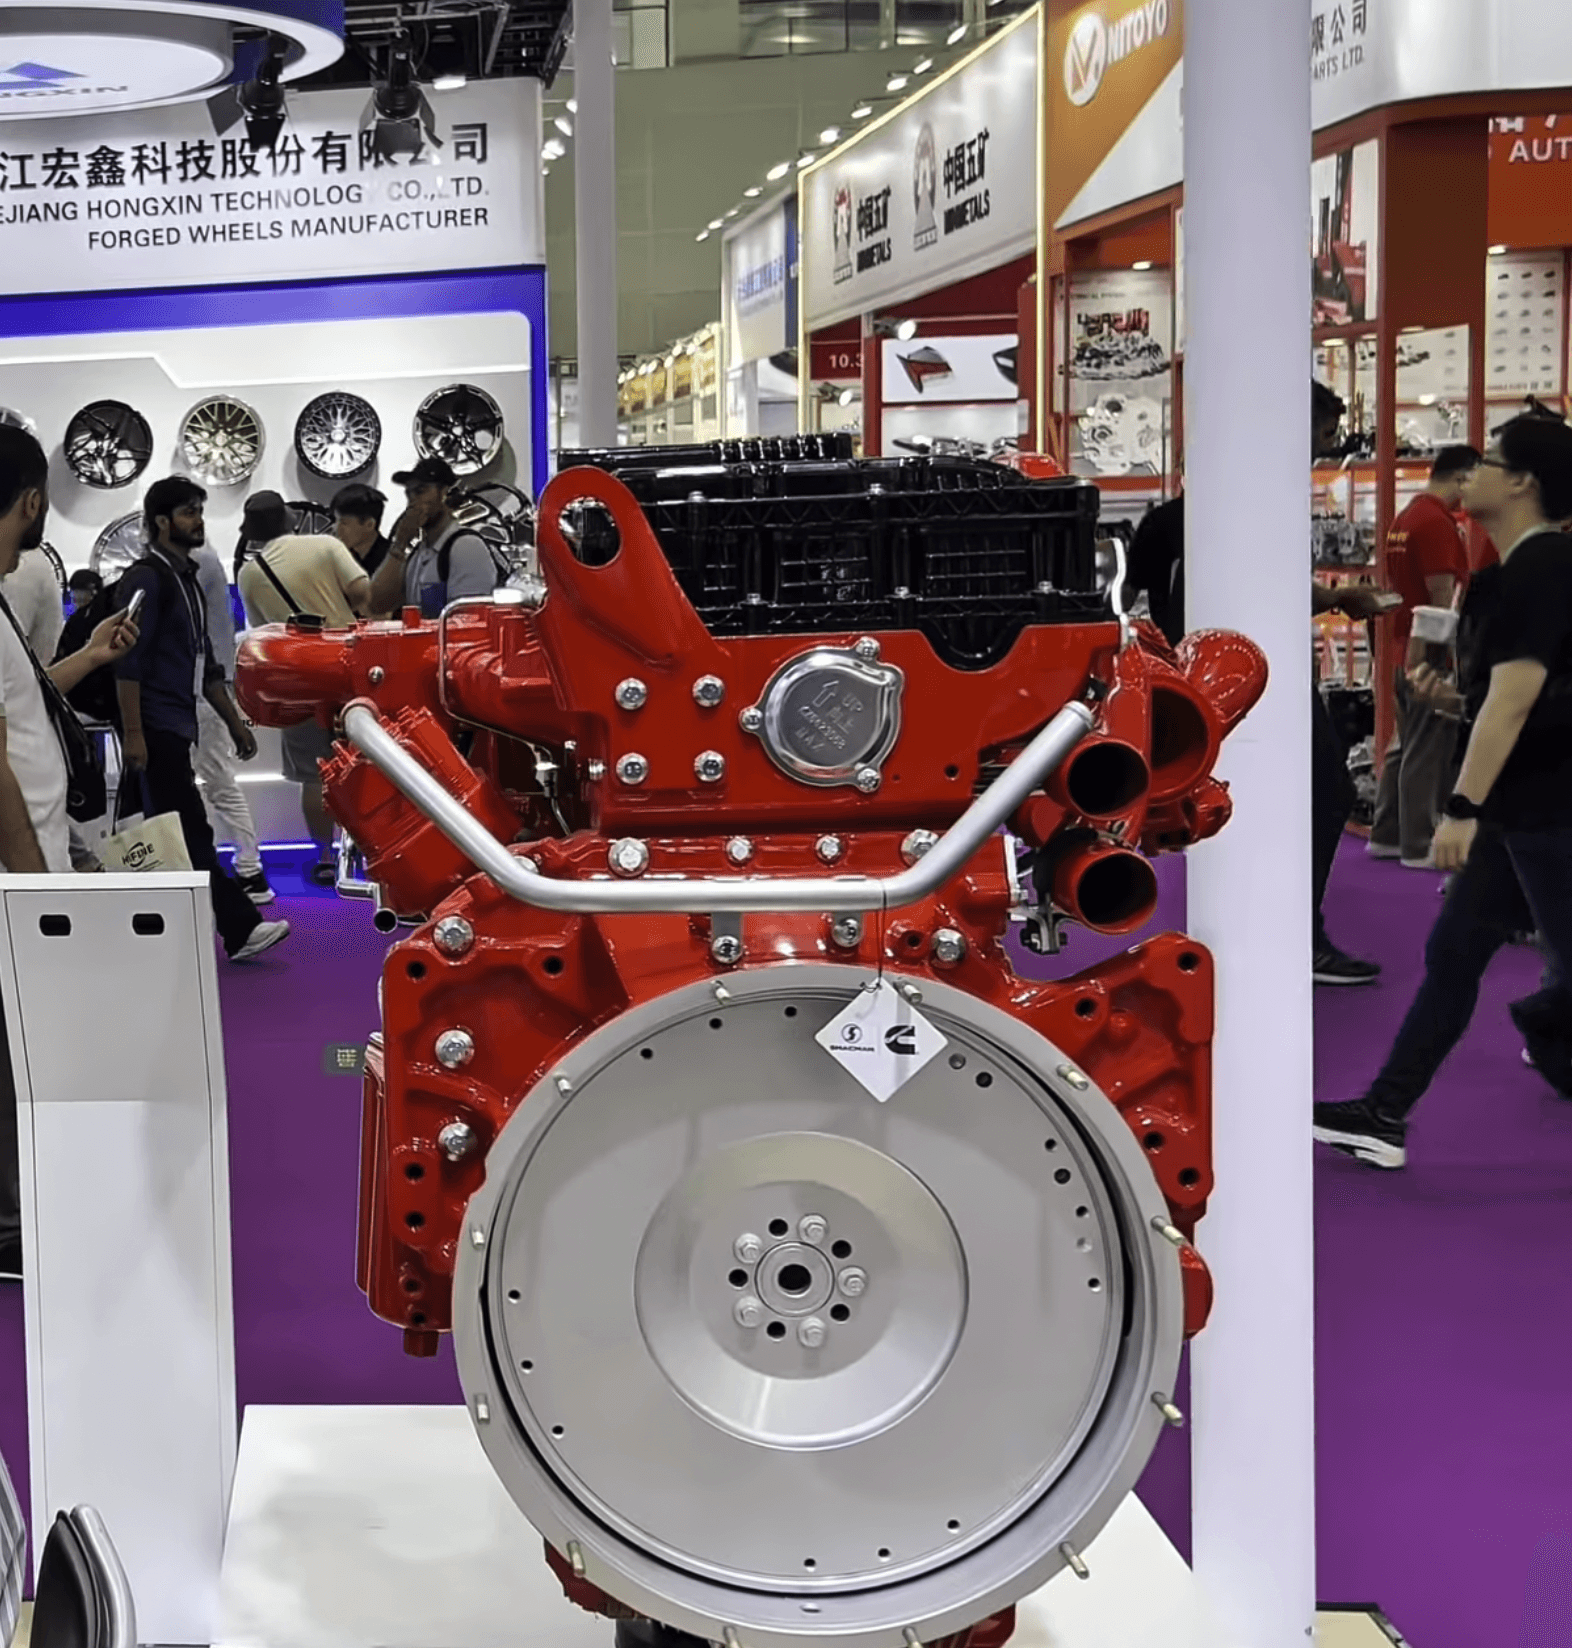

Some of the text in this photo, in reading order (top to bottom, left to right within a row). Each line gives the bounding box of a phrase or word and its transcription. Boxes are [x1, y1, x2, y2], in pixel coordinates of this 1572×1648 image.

[1108, 0, 1168, 64] NITOYO
[1310, 54, 1339, 80] ARTS
[943, 127, 990, 200] 中国五矿
[87, 193, 203, 220] HONGXIN
[210, 184, 374, 212] TECHNOLOG
[387, 176, 490, 202] CO.,TD.
[88, 206, 490, 250] FORGED WHEELS MANUFACTURER
